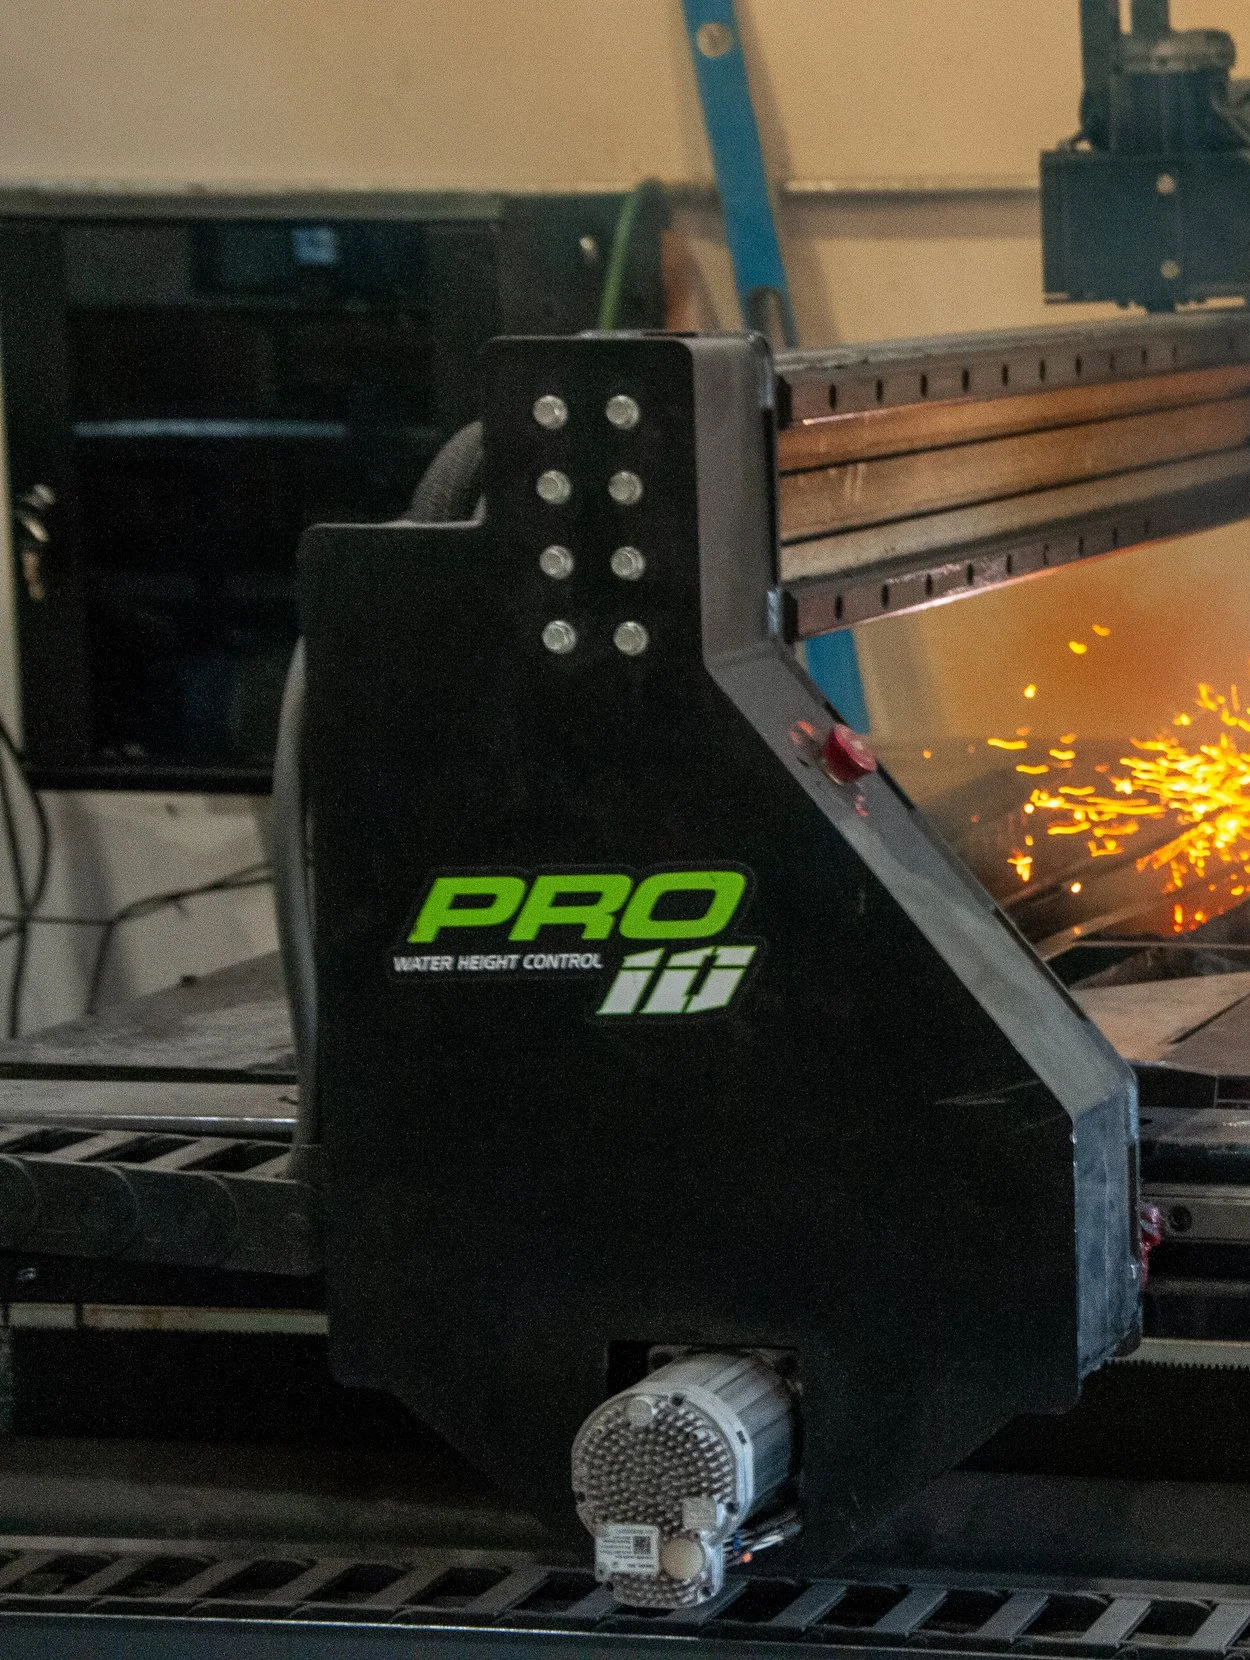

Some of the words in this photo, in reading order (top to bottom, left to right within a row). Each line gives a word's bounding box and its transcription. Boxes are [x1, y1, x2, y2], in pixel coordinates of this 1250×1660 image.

[407, 871, 746, 943] PRO
[393, 955, 453, 972] WATER
[457, 954, 519, 971] HEIGHT
[522, 953, 603, 970] CONTROL
